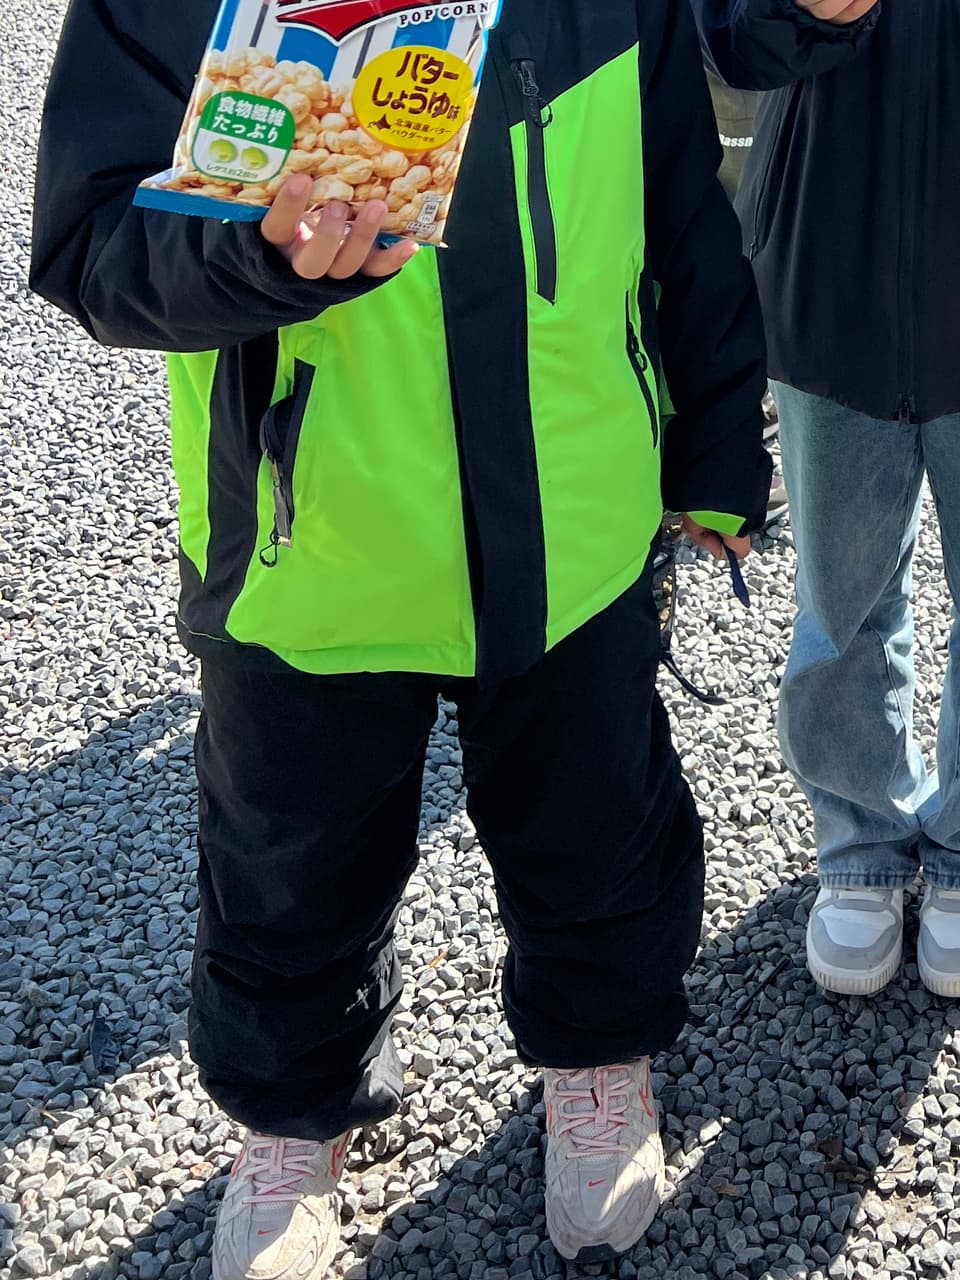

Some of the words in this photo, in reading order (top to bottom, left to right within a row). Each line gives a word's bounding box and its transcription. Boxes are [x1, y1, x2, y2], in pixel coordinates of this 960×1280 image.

[395, 51, 459, 84] バター
[217, 96, 286, 127] 食物繊維
[372, 77, 460, 120] しょうゆ味
[212, 114, 279, 143] たっぷり
